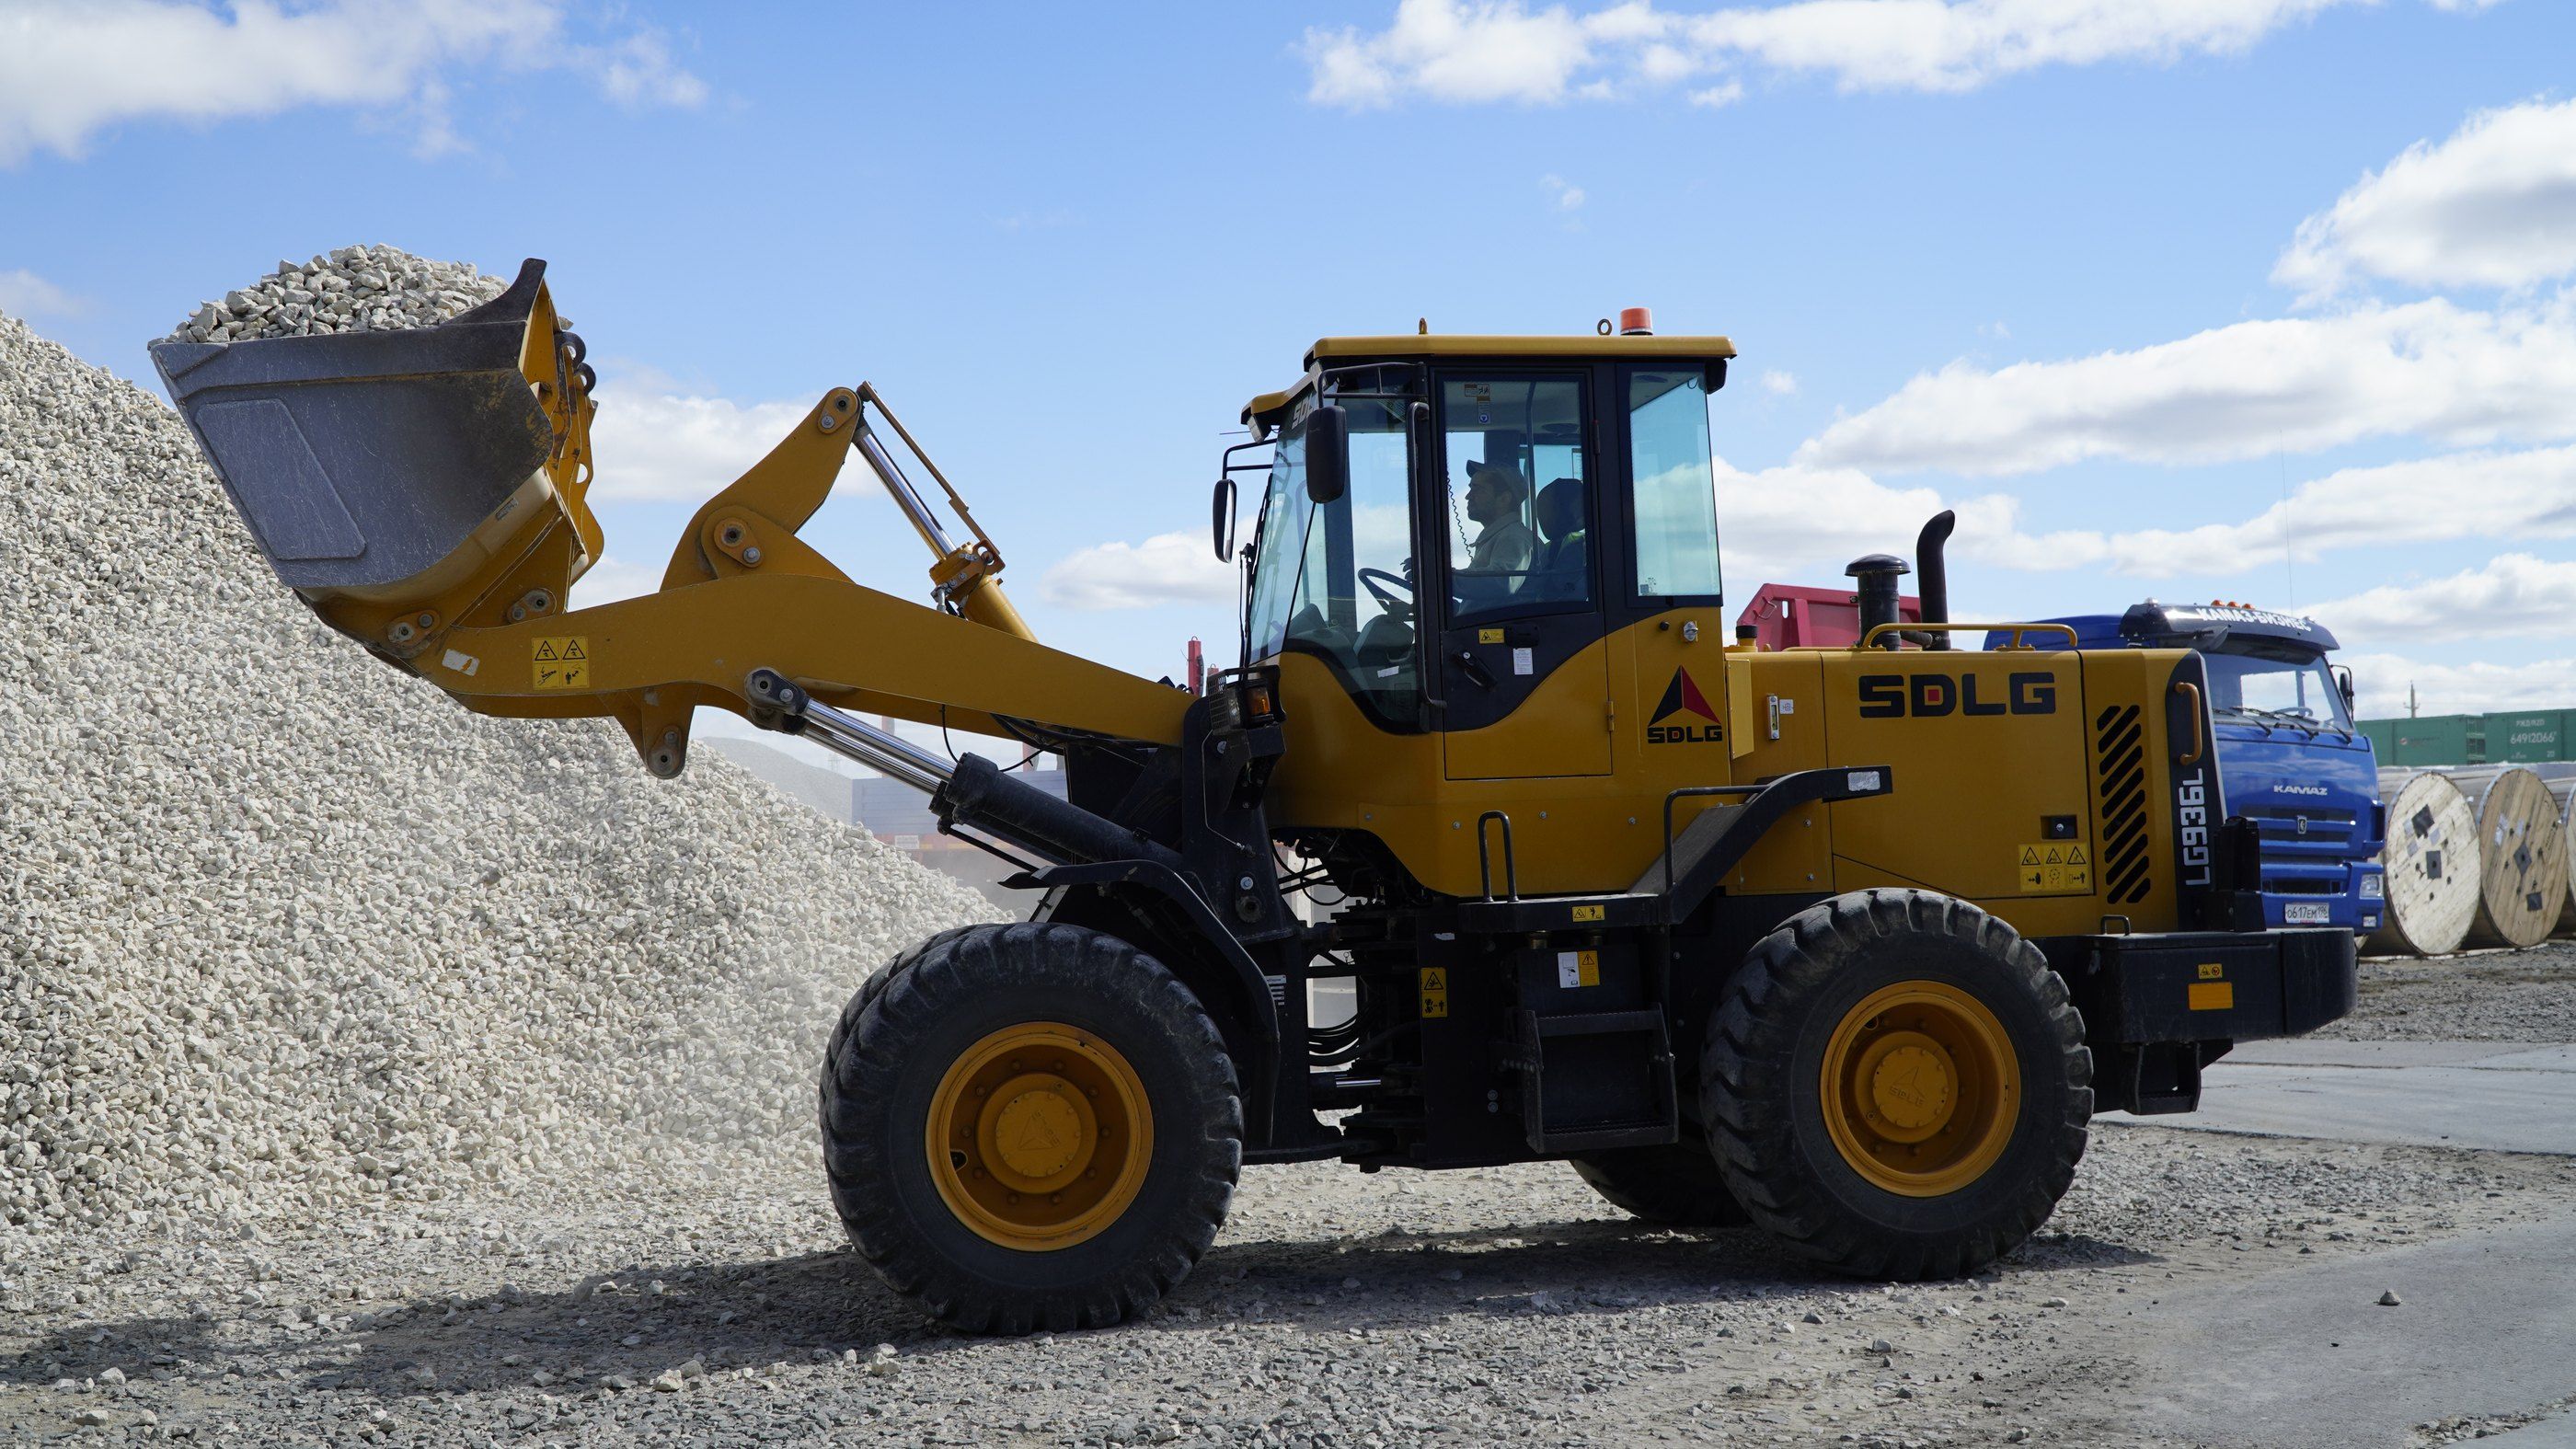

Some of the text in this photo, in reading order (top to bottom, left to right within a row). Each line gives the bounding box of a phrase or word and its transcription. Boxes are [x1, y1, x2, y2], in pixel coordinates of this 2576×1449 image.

[1292, 392, 1316, 430] SDL
[1858, 672, 2056, 719] SDLG
[1647, 725, 1723, 744] SDLG
[2273, 785, 2329, 797] KAMAZ
[2179, 768, 2211, 886] LG936L
